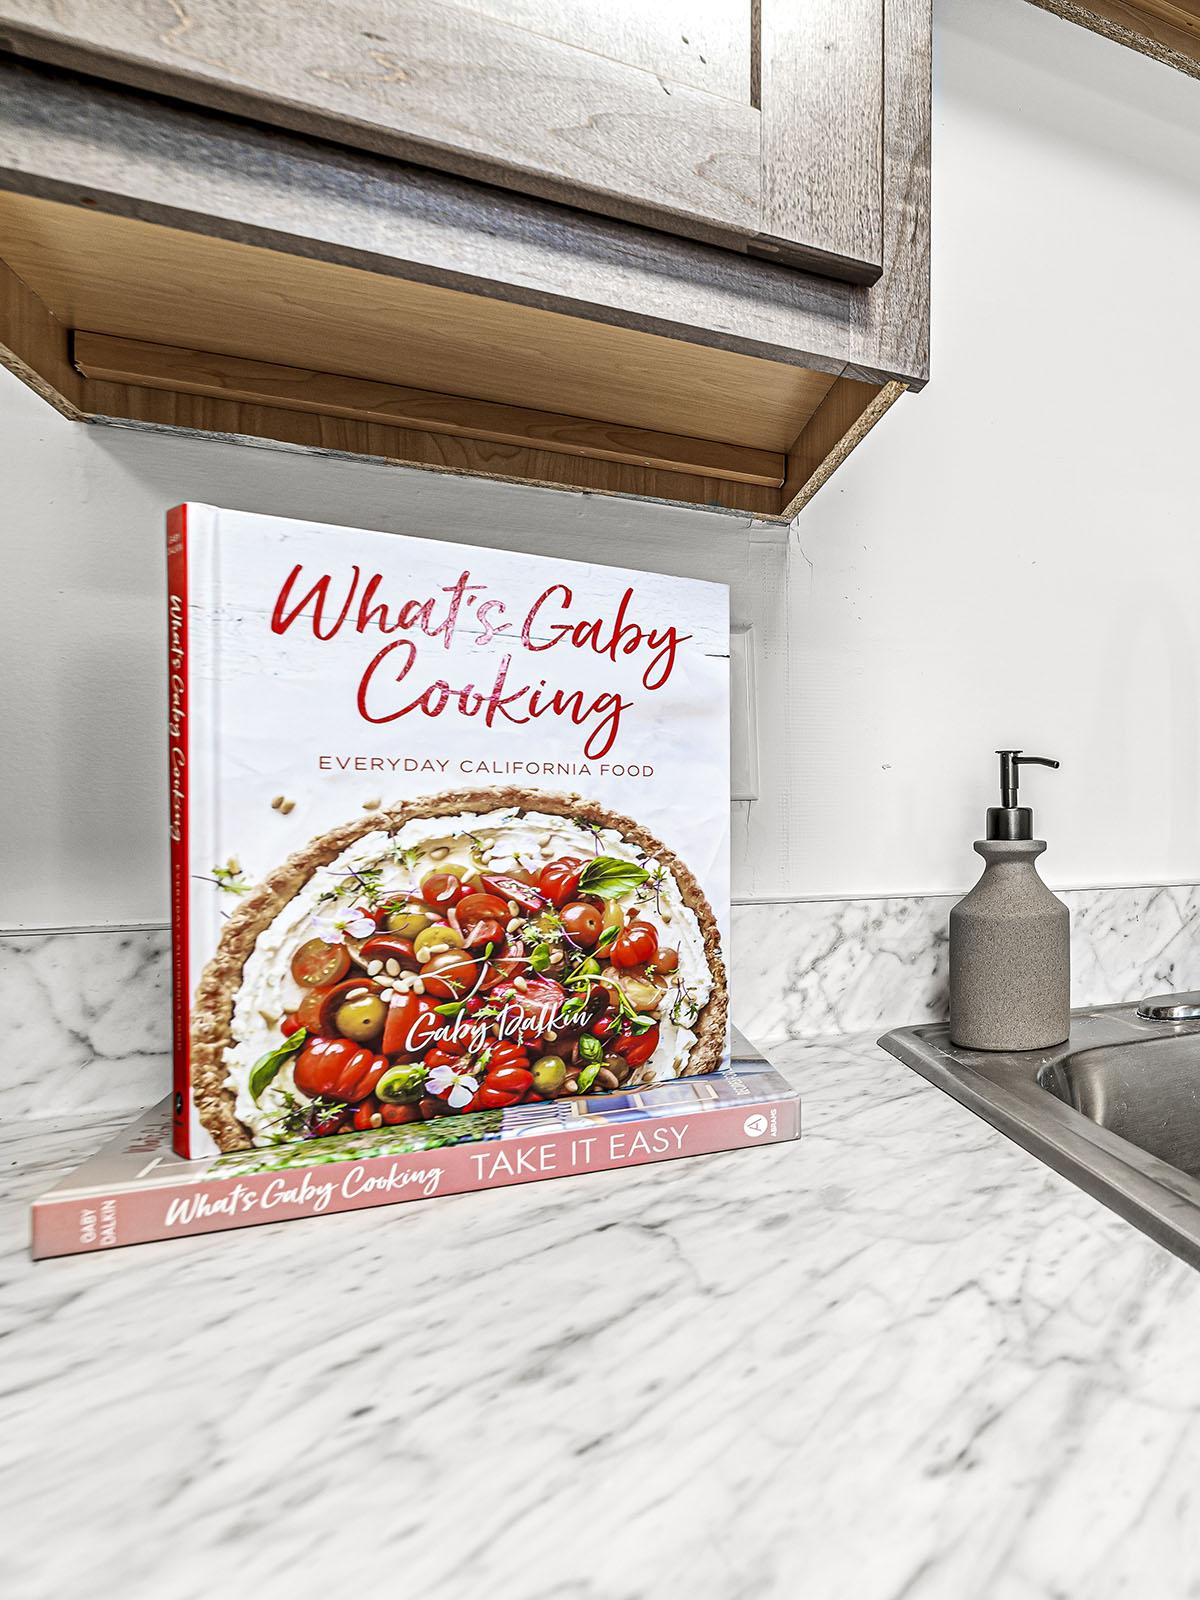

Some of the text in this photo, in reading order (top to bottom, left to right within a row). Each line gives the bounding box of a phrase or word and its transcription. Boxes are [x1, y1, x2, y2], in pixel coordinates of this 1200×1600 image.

[271, 564, 692, 690] What's Gaby
[357, 639, 633, 760] Cooking
[319, 756, 655, 778] EVERYDAY CALIFORNIA FOOD
[405, 1003, 593, 1053] Gaby Dalkin
[470, 1124, 689, 1181] TAKE IT EASY
[164, 1162, 445, 1227] What's Gaby Cooking
[80, 1208, 97, 1244] GABY
[100, 1199, 117, 1246] DALKIN
